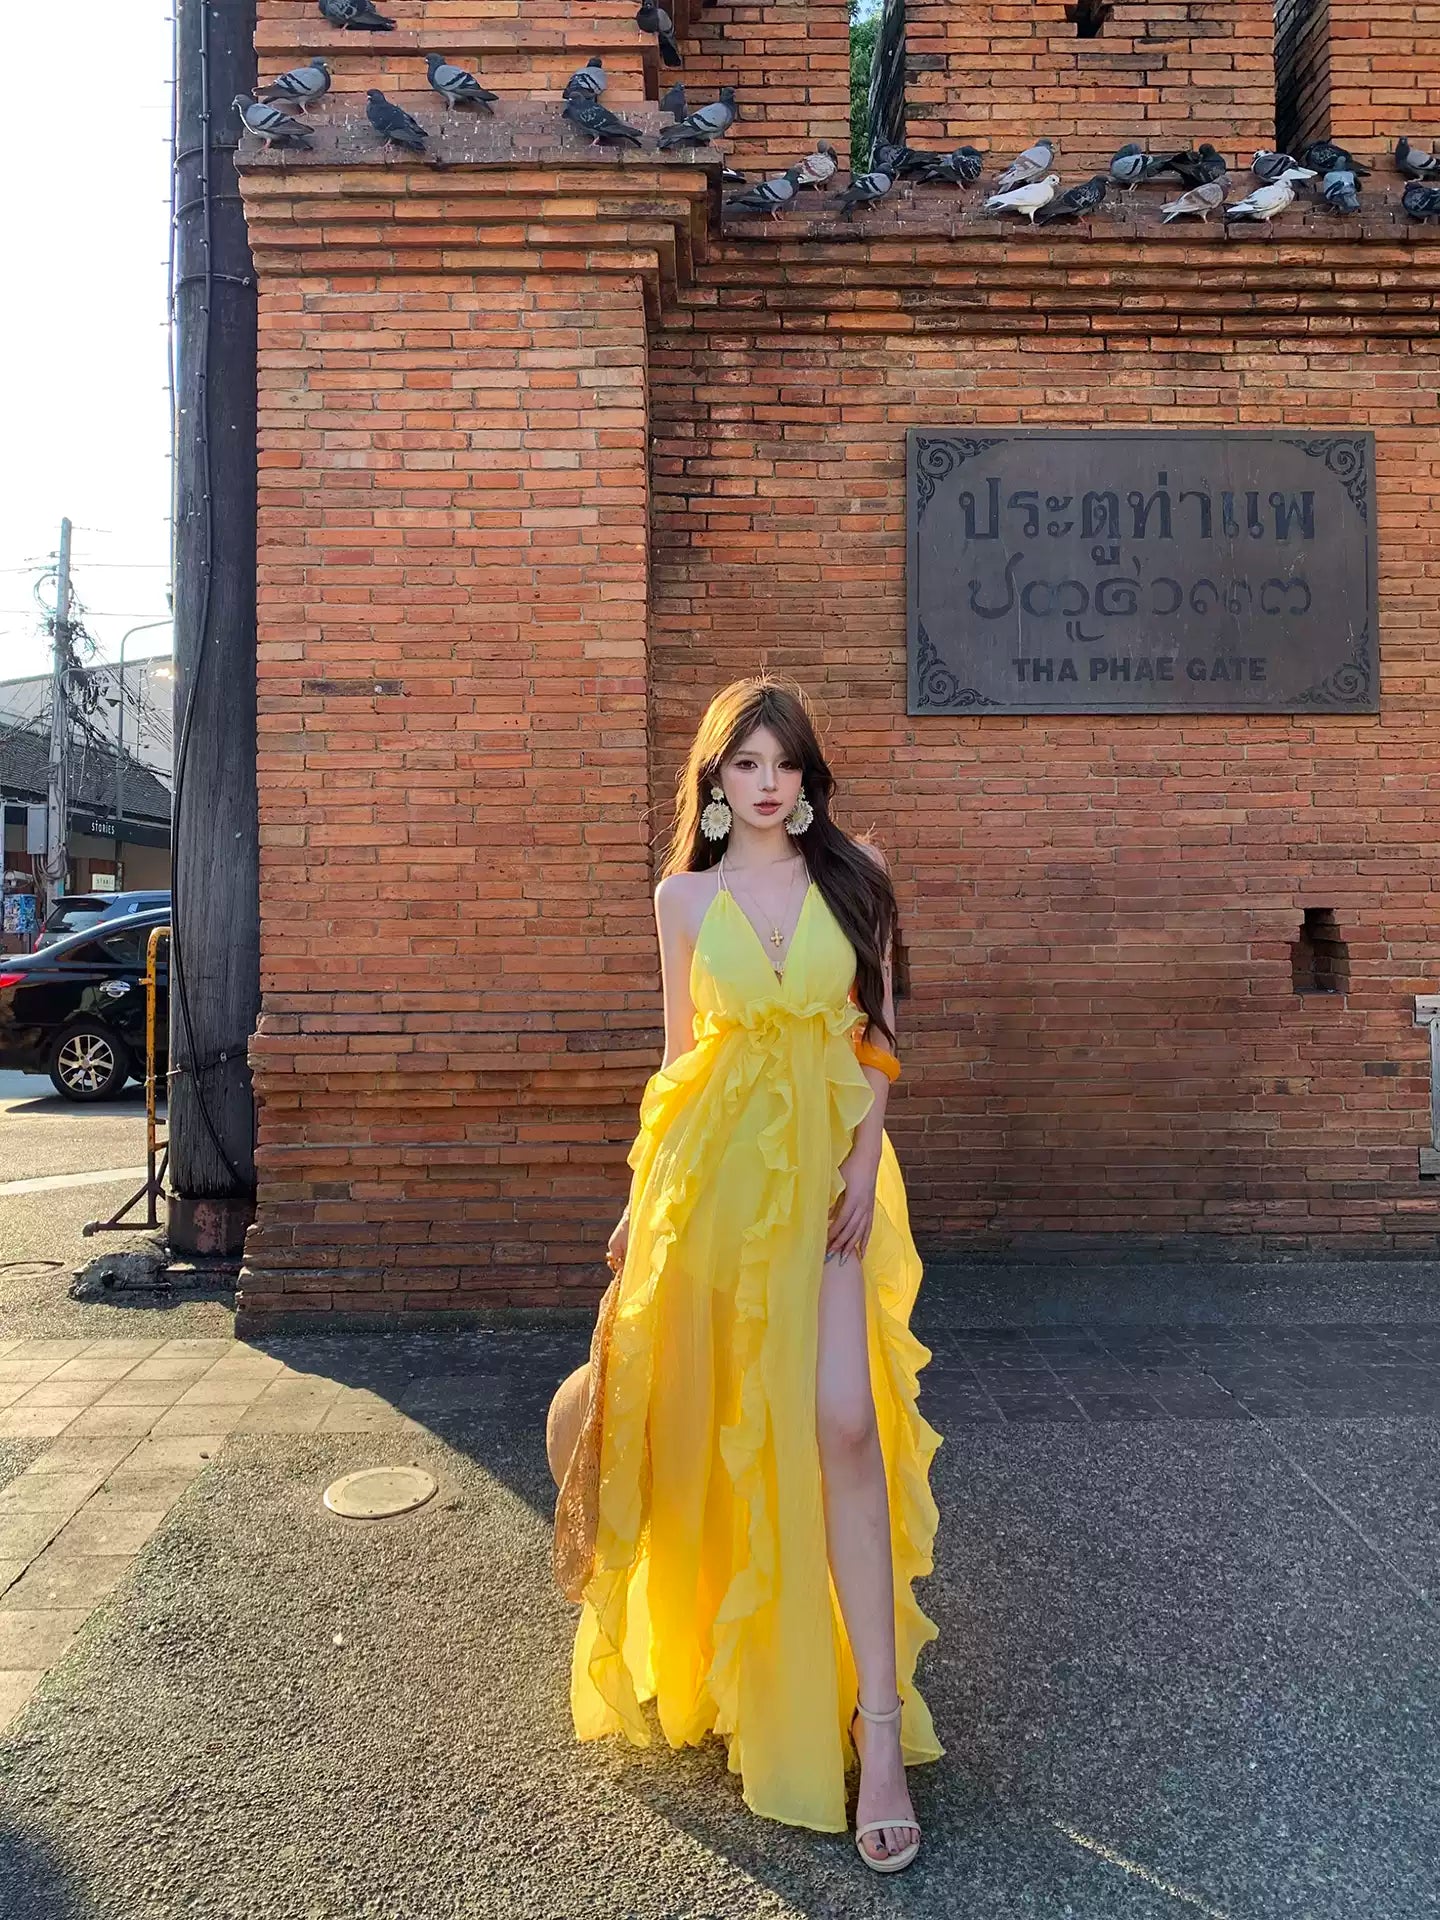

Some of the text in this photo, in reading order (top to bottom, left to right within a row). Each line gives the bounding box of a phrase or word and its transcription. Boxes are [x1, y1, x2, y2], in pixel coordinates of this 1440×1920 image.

[958, 471, 1315, 566] ประตูท่าแพ
[1012, 657, 1267, 682] THA PHAE GATE
